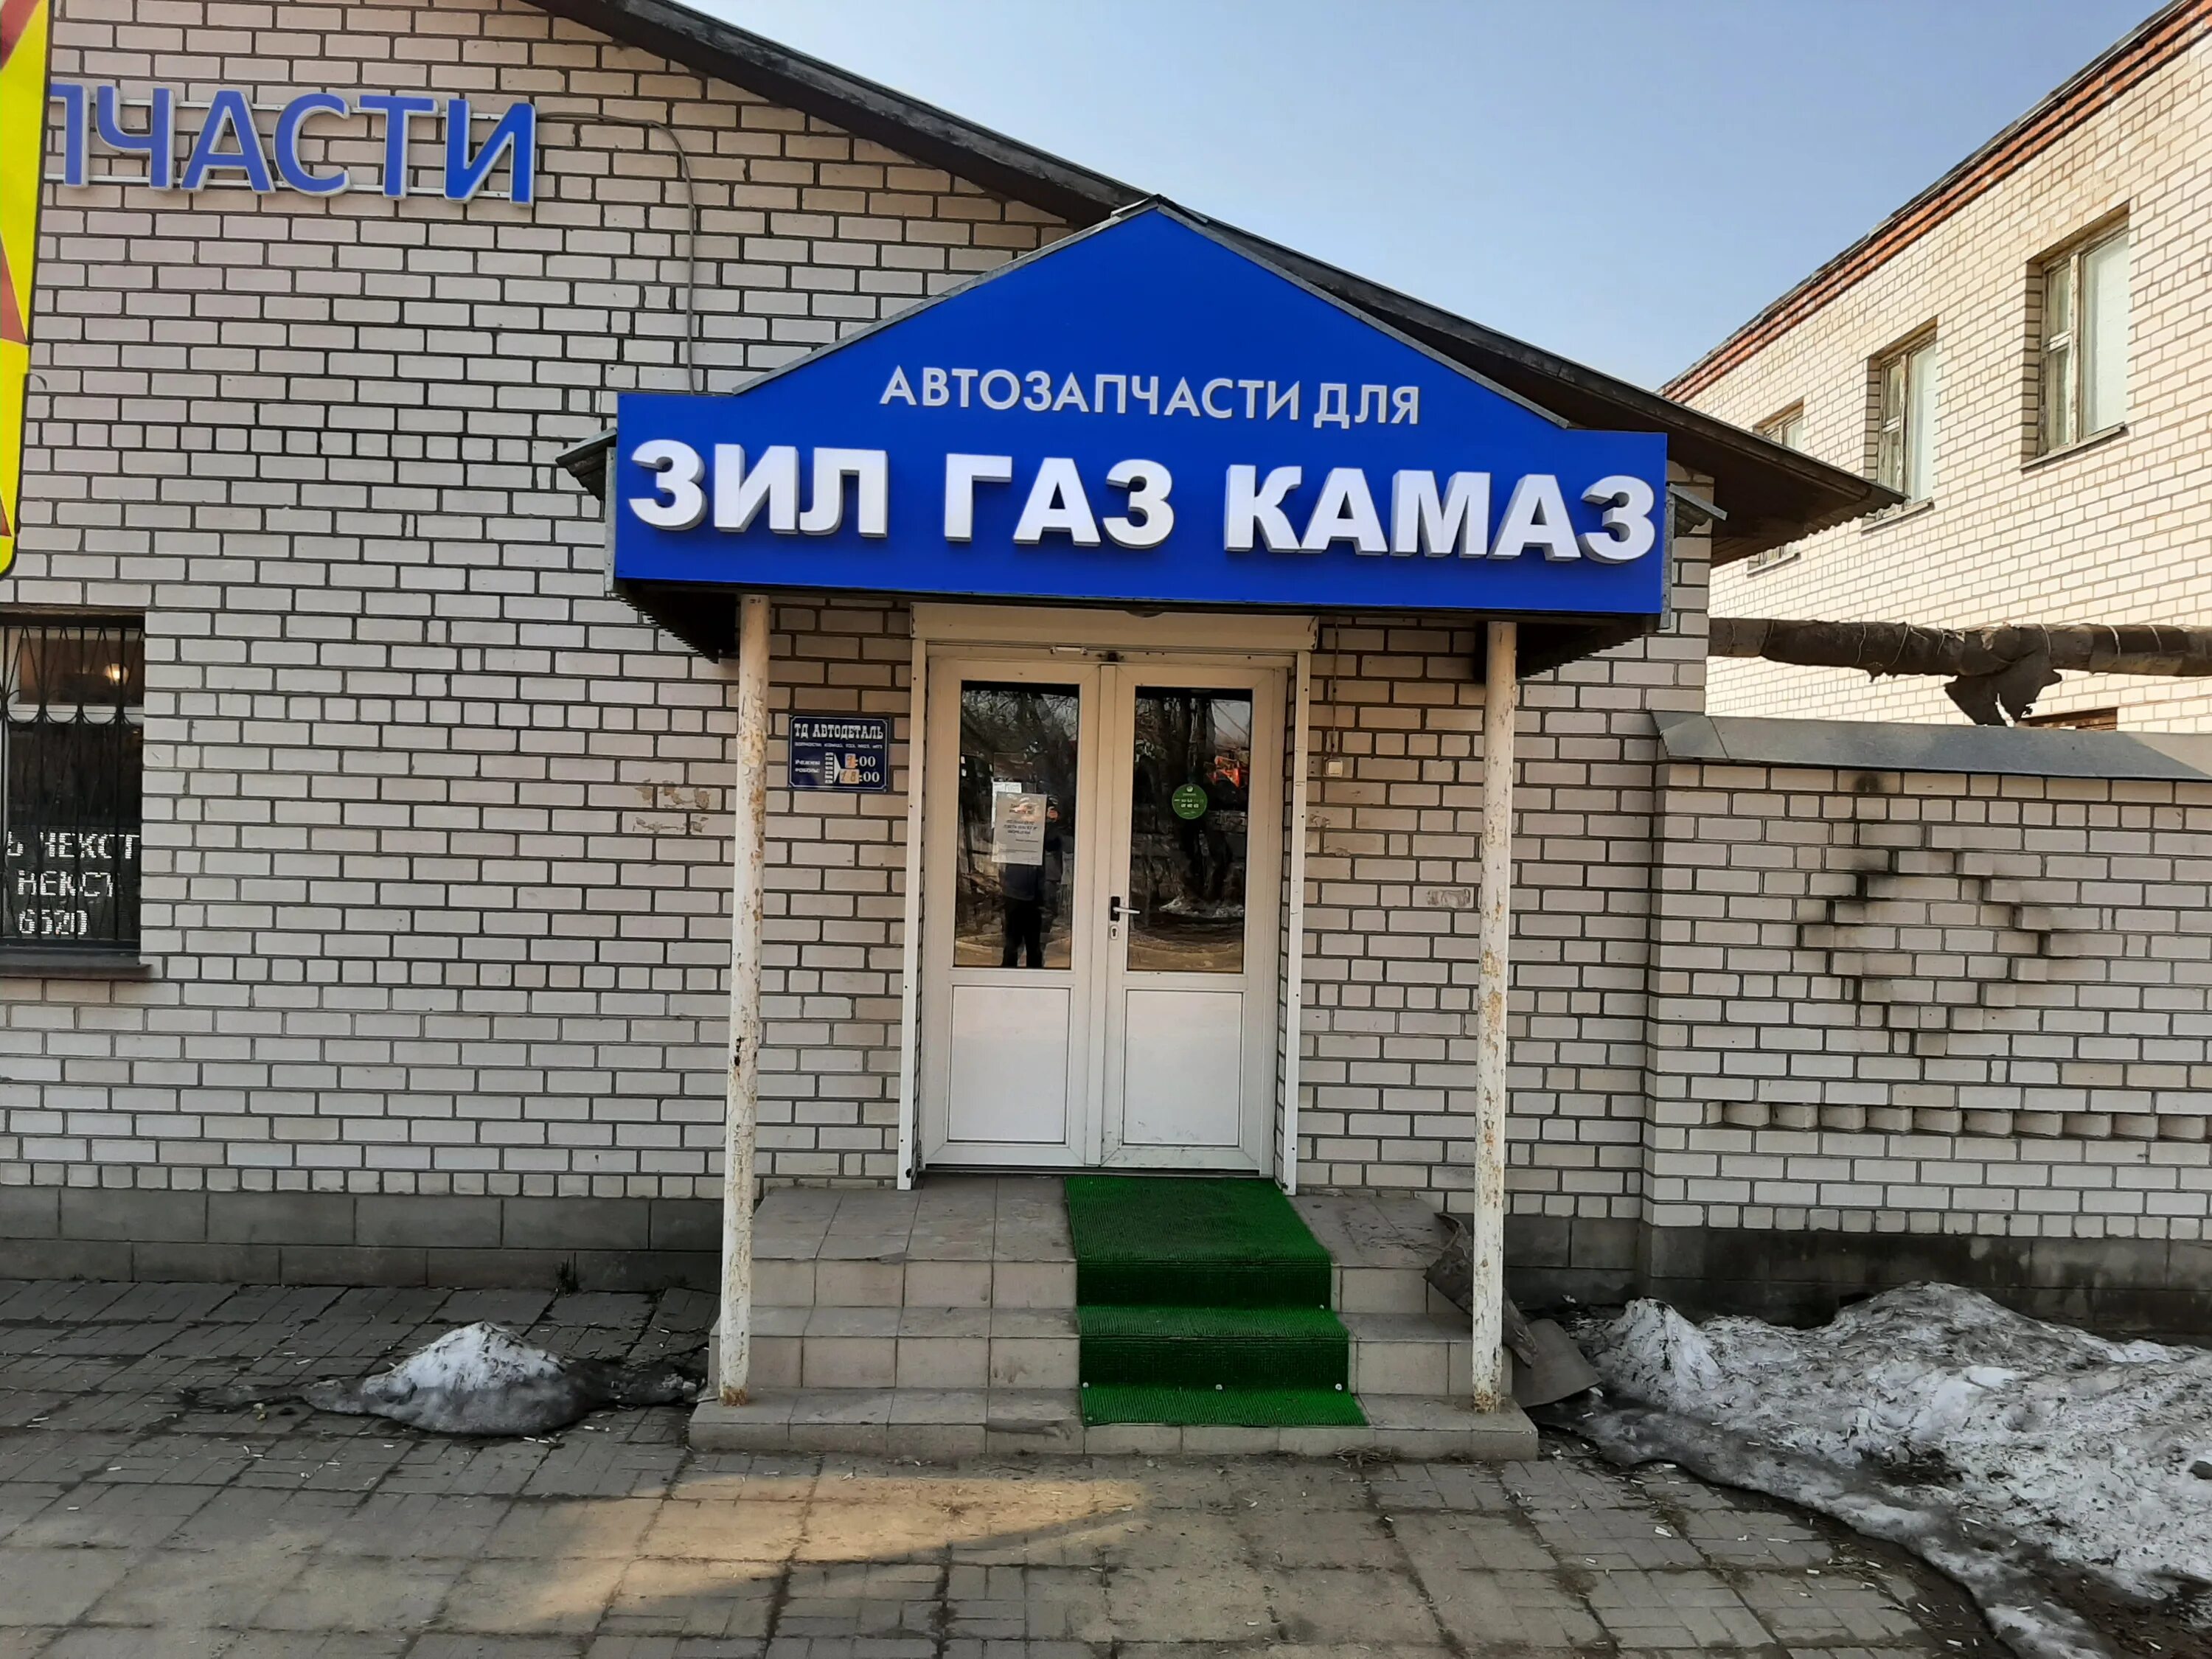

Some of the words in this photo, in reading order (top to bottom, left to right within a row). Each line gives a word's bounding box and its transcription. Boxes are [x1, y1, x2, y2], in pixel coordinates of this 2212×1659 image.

[880, 366, 1299, 421] АВТОЗАПЧАСТИ
[1313, 383, 1419, 429] ДЛЯ
[629, 439, 887, 538] ЗИЛ
[945, 453, 1174, 546] ГАЗ
[1224, 465, 1655, 563] КАМАЗ
[794, 723, 809, 739] ТД
[813, 723, 884, 740] АВТОДЕТАЛЬ
